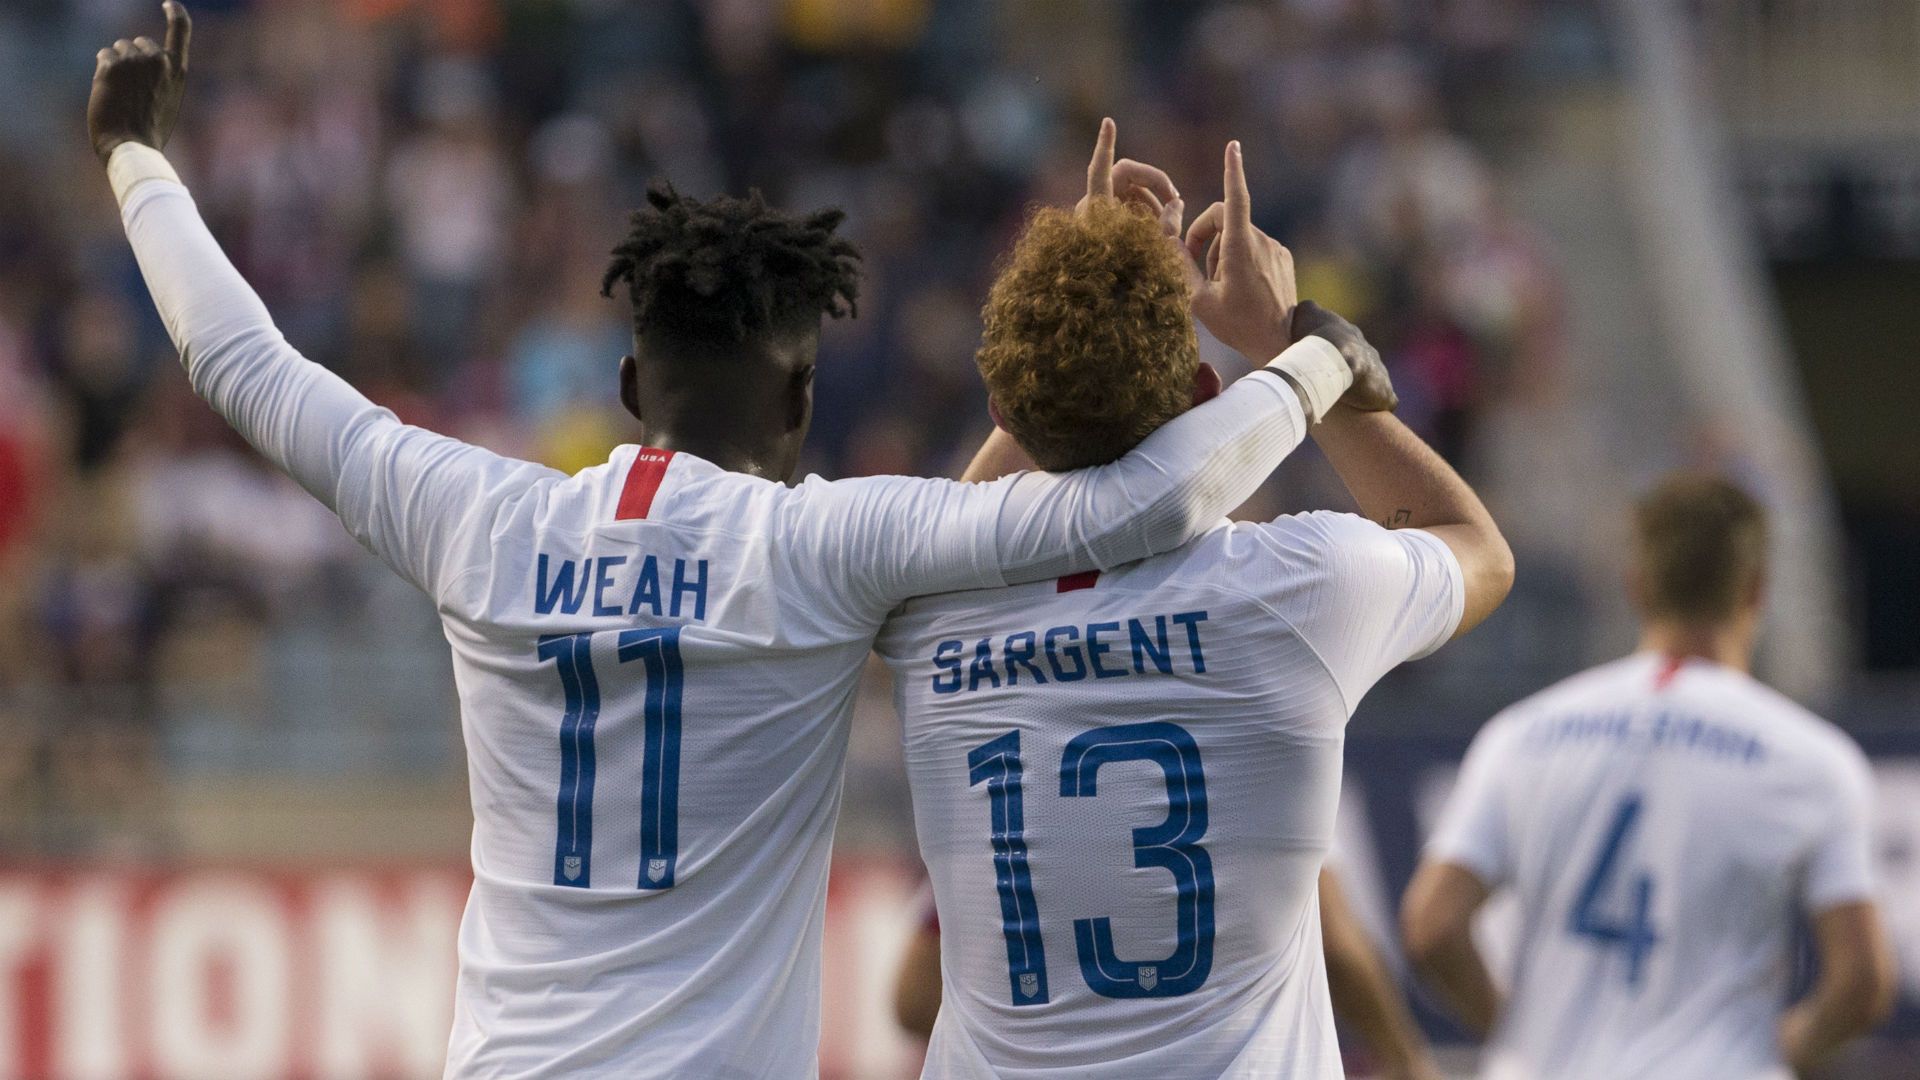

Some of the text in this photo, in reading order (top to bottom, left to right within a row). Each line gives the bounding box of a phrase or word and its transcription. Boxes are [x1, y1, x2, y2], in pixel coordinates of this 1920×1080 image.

[640, 454, 666, 462] USA
[535, 553, 708, 620] WEAH
[932, 610, 1208, 694] SARGENT
[537, 627, 684, 889] 11
[967, 722, 1215, 1006] 13
[1567, 794, 1658, 990] 4
